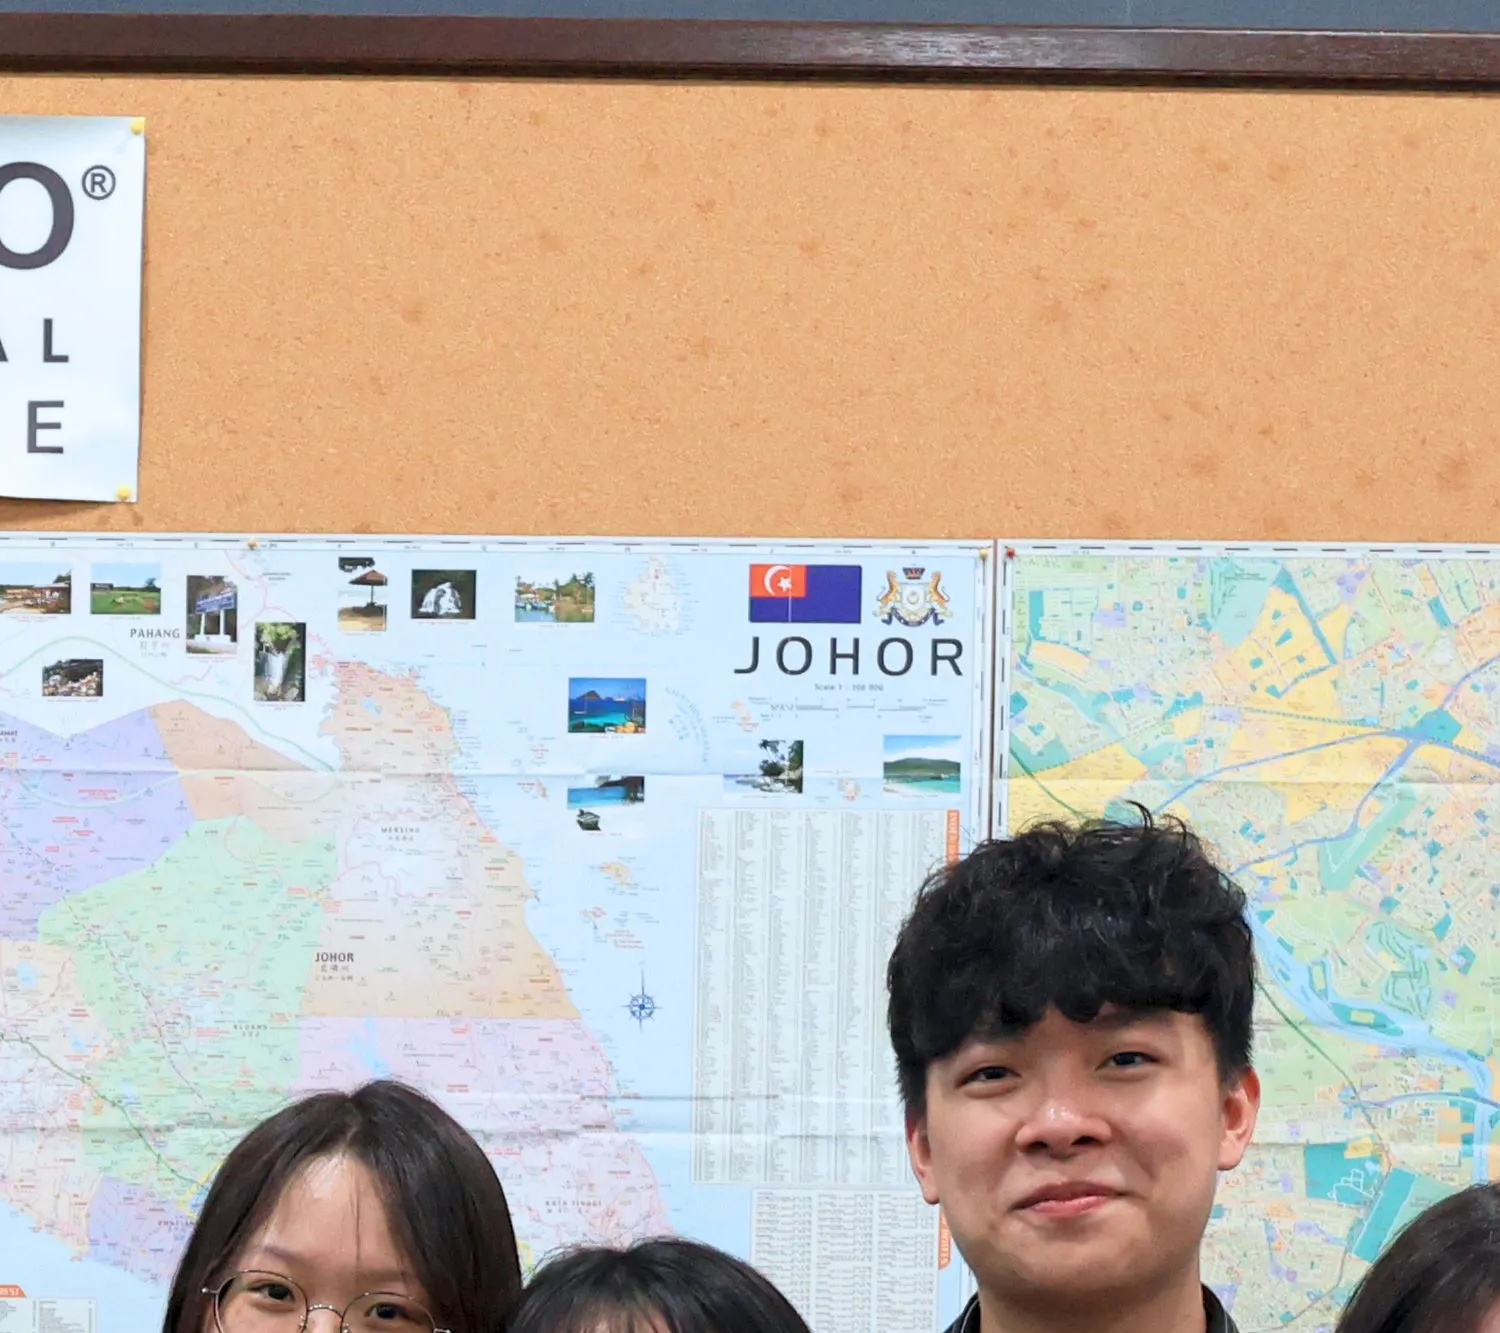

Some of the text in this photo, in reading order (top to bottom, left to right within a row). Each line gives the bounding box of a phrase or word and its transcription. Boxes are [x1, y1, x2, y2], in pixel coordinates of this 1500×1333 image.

[129, 627, 182, 640] PAHANG
[734, 635, 964, 677] JOHOR
[313, 951, 355, 964] JOHOR
